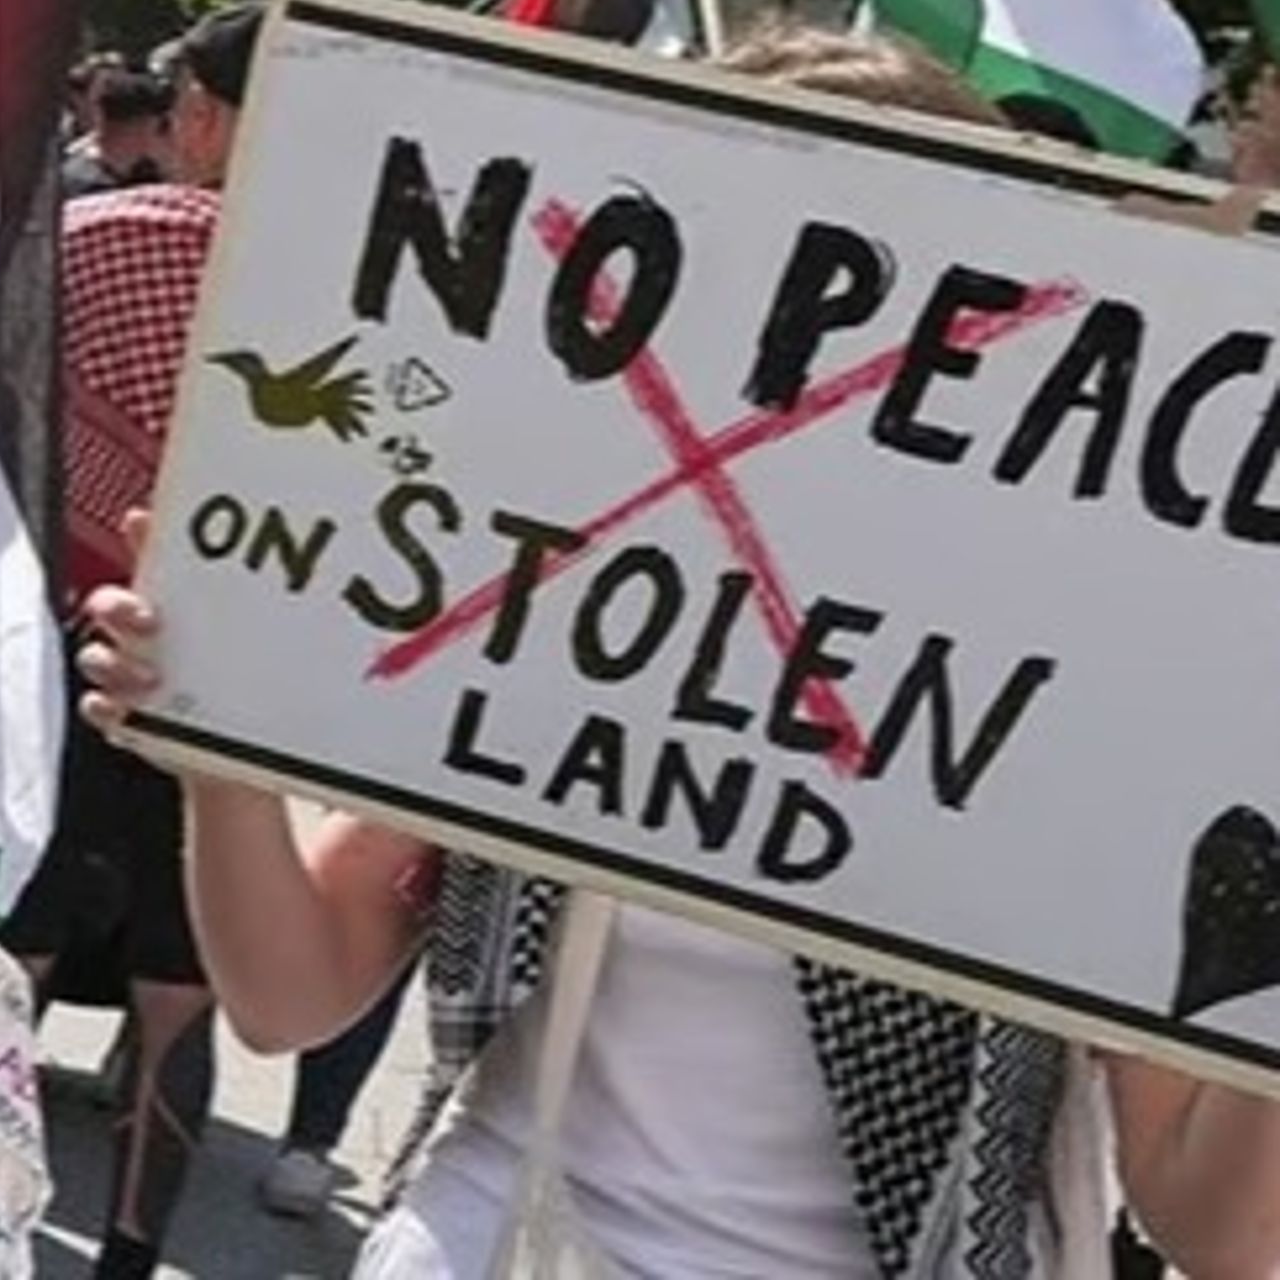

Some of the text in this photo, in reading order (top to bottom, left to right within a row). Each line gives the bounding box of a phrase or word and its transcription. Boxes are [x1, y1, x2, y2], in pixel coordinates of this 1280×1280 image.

[350, 135, 684, 385] NO
[187, 480, 1057, 811] ON STOLEN
[441, 688, 858, 886] LAND
